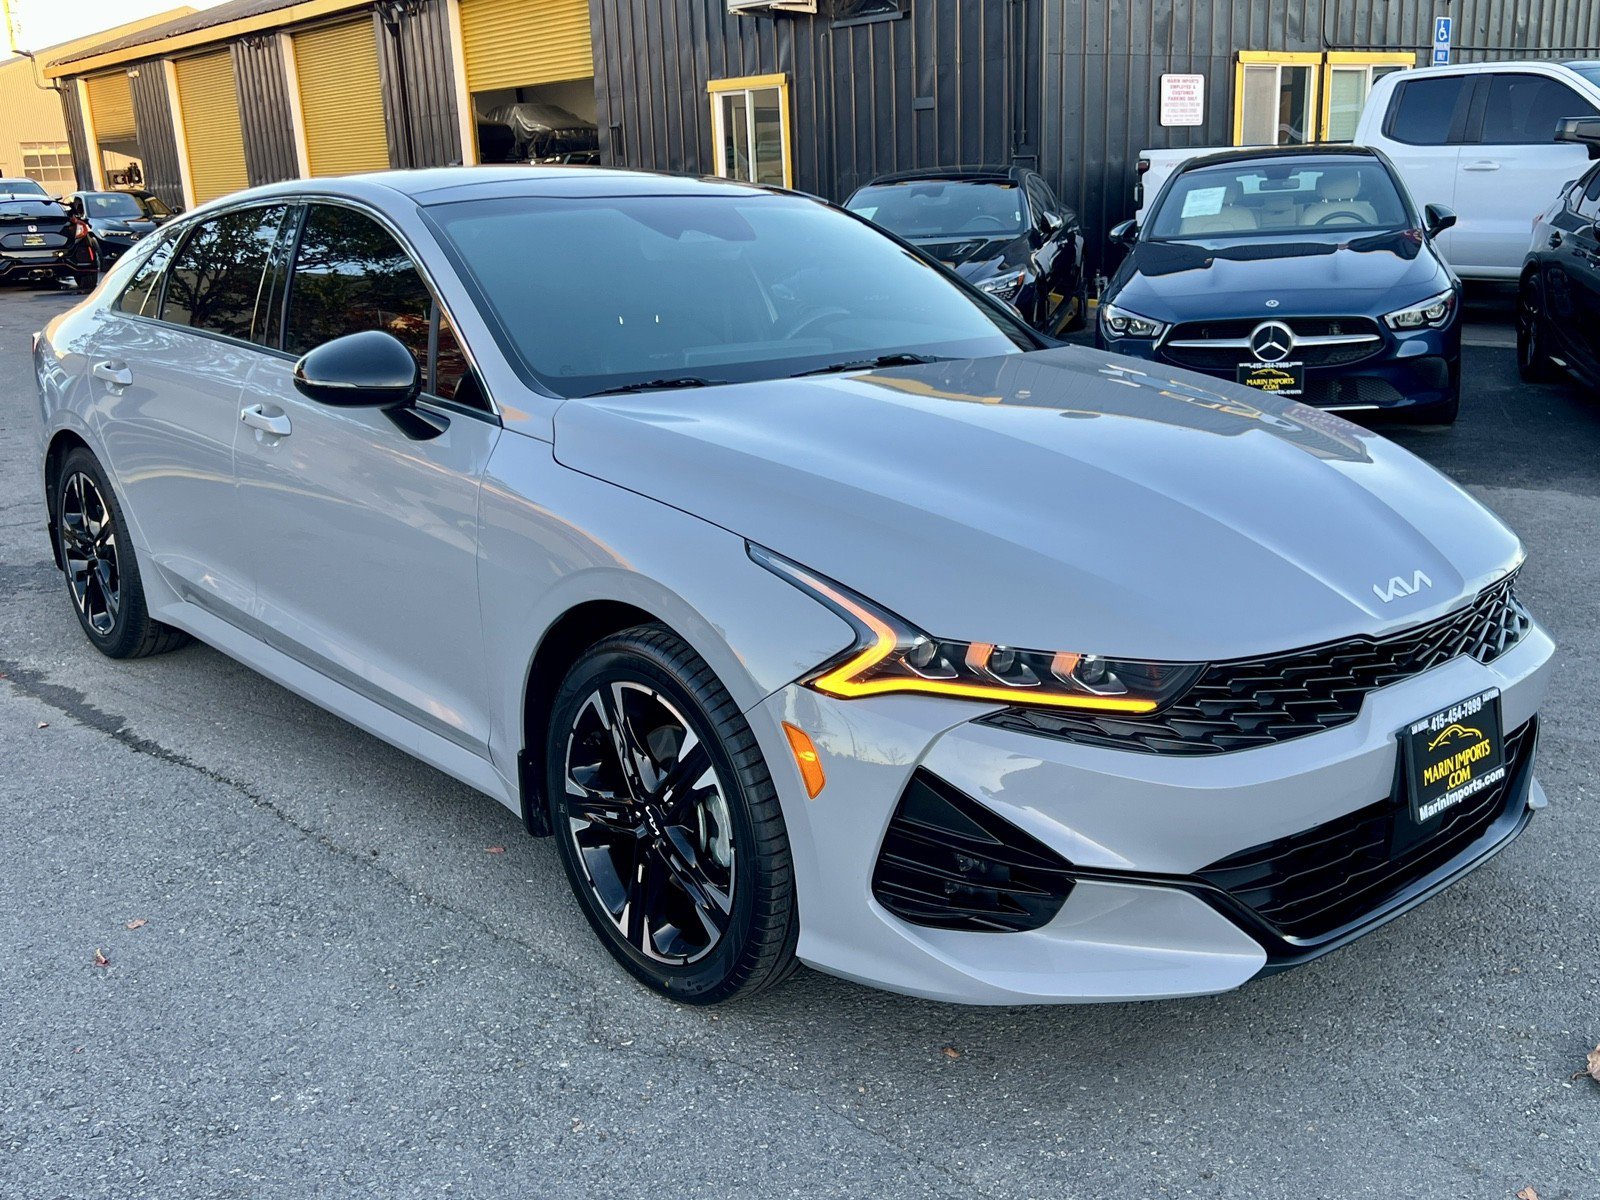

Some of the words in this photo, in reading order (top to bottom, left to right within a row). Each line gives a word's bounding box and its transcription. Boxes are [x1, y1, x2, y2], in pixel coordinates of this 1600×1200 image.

[1372, 569, 1432, 603] KIA
[1430, 696, 1481, 731] 415-454-7999
[1423, 757, 1454, 786] MARIN
[1455, 739, 1491, 769] IMPORTS
[1419, 767, 1505, 821] MarinImports.com
